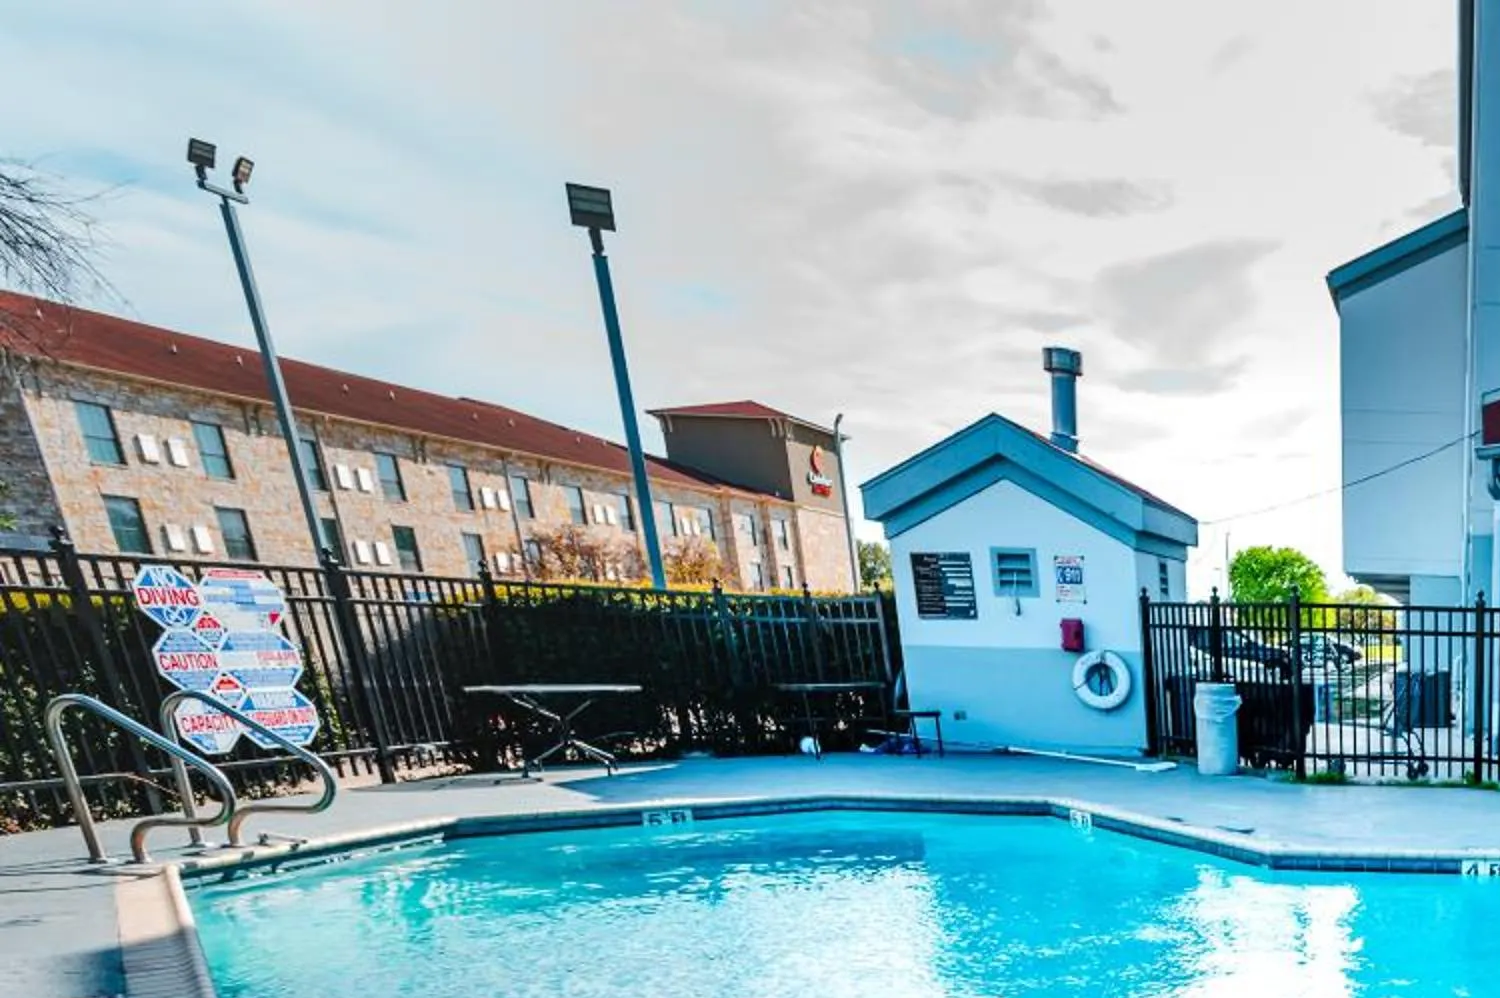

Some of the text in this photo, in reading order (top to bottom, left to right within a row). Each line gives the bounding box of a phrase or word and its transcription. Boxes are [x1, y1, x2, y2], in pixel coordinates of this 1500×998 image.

[149, 567, 177, 587] NO
[137, 587, 200, 607] DIVING
[159, 652, 218, 671] CAUTION
[181, 713, 238, 732] CAPACITY
[1465, 863, 1478, 876] 4
